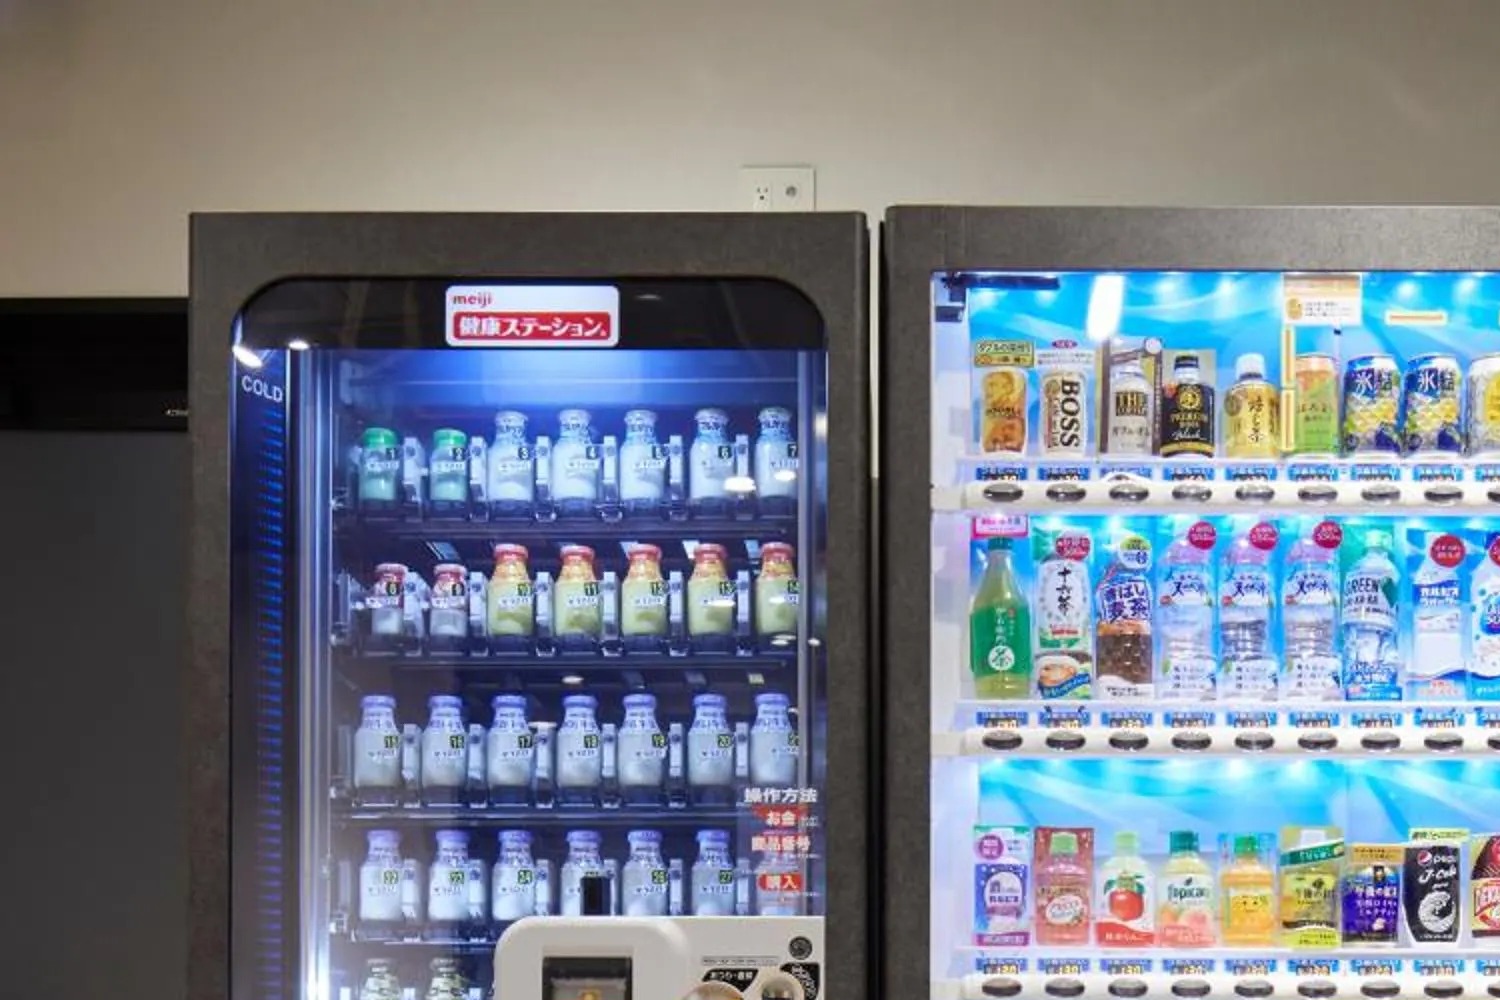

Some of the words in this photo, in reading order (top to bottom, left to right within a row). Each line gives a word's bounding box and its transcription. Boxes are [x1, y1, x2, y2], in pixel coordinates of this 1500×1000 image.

[453, 292, 493, 308] meiji
[459, 316, 604, 338] 健康ステーション
[241, 374, 283, 403] COLD
[1353, 367, 1393, 397] 氷結
[1418, 367, 1455, 395] 氷結
[1060, 379, 1080, 447] BOSS
[1345, 577, 1379, 596] GREEN
[744, 787, 818, 803] 操作方法
